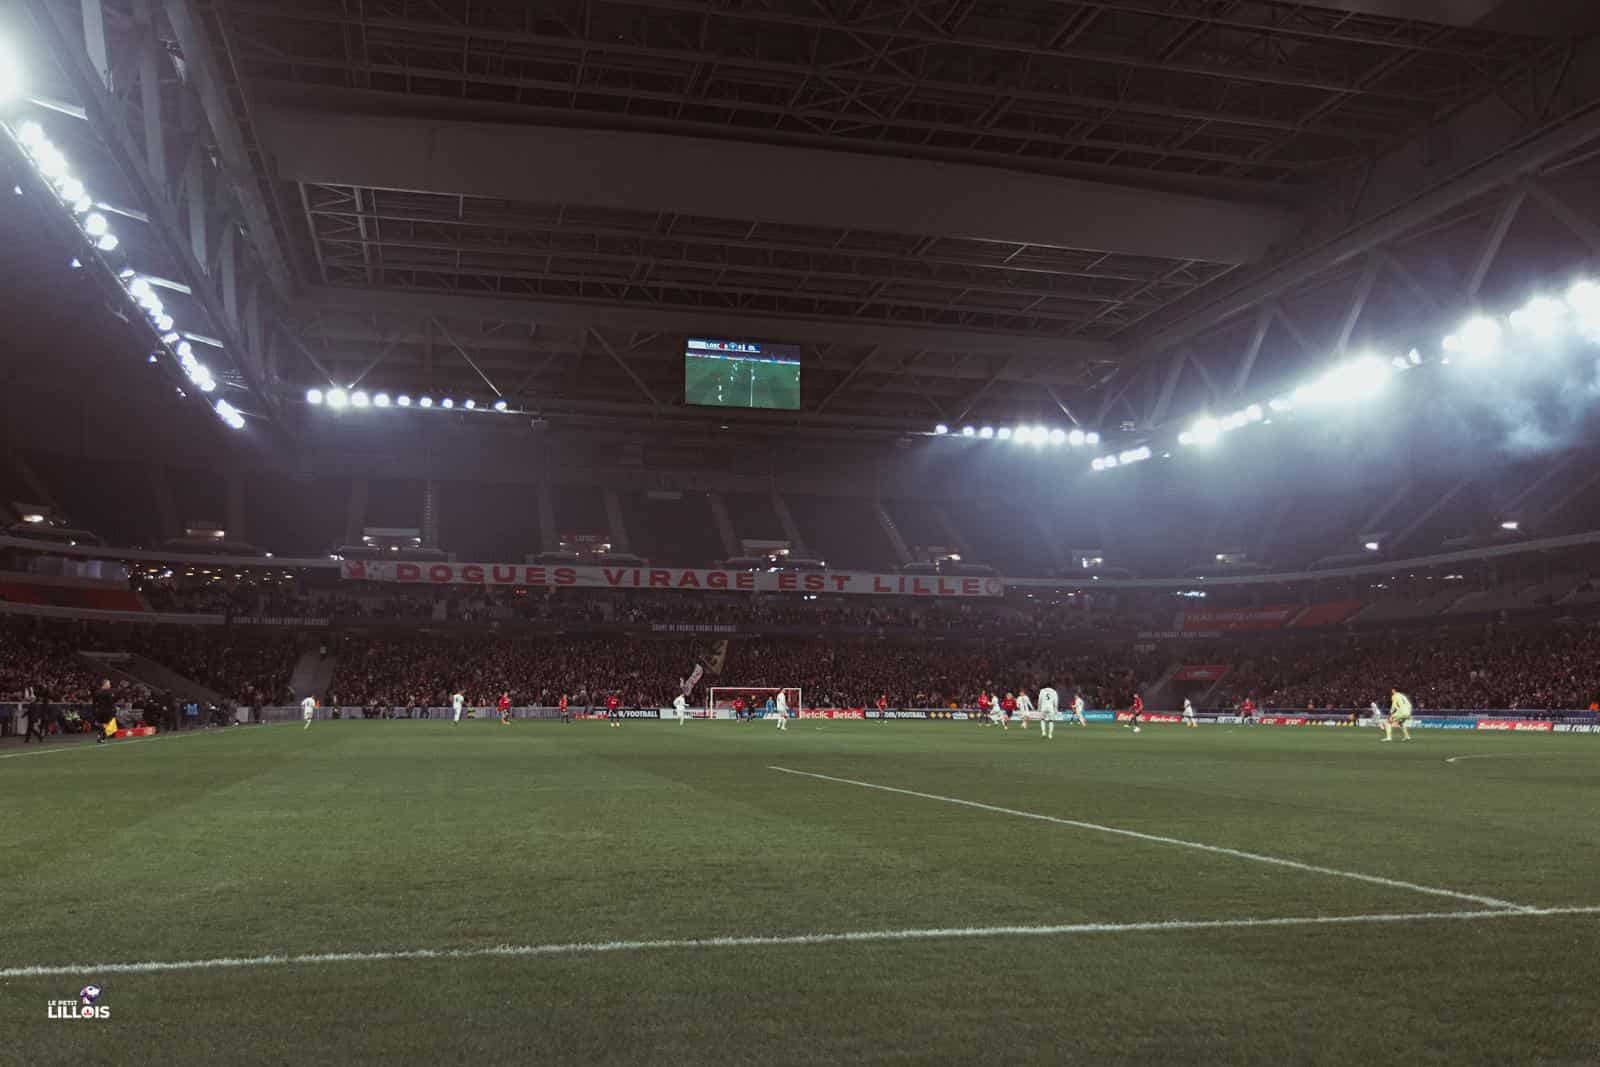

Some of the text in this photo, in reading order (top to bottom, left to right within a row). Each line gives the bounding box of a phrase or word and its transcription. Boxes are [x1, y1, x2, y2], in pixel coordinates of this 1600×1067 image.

[396, 563, 979, 595] DOGUES VIRAGE EST LILLE
[1046, 693, 1050, 701] 5
[833, 710, 863, 720] Betclic
